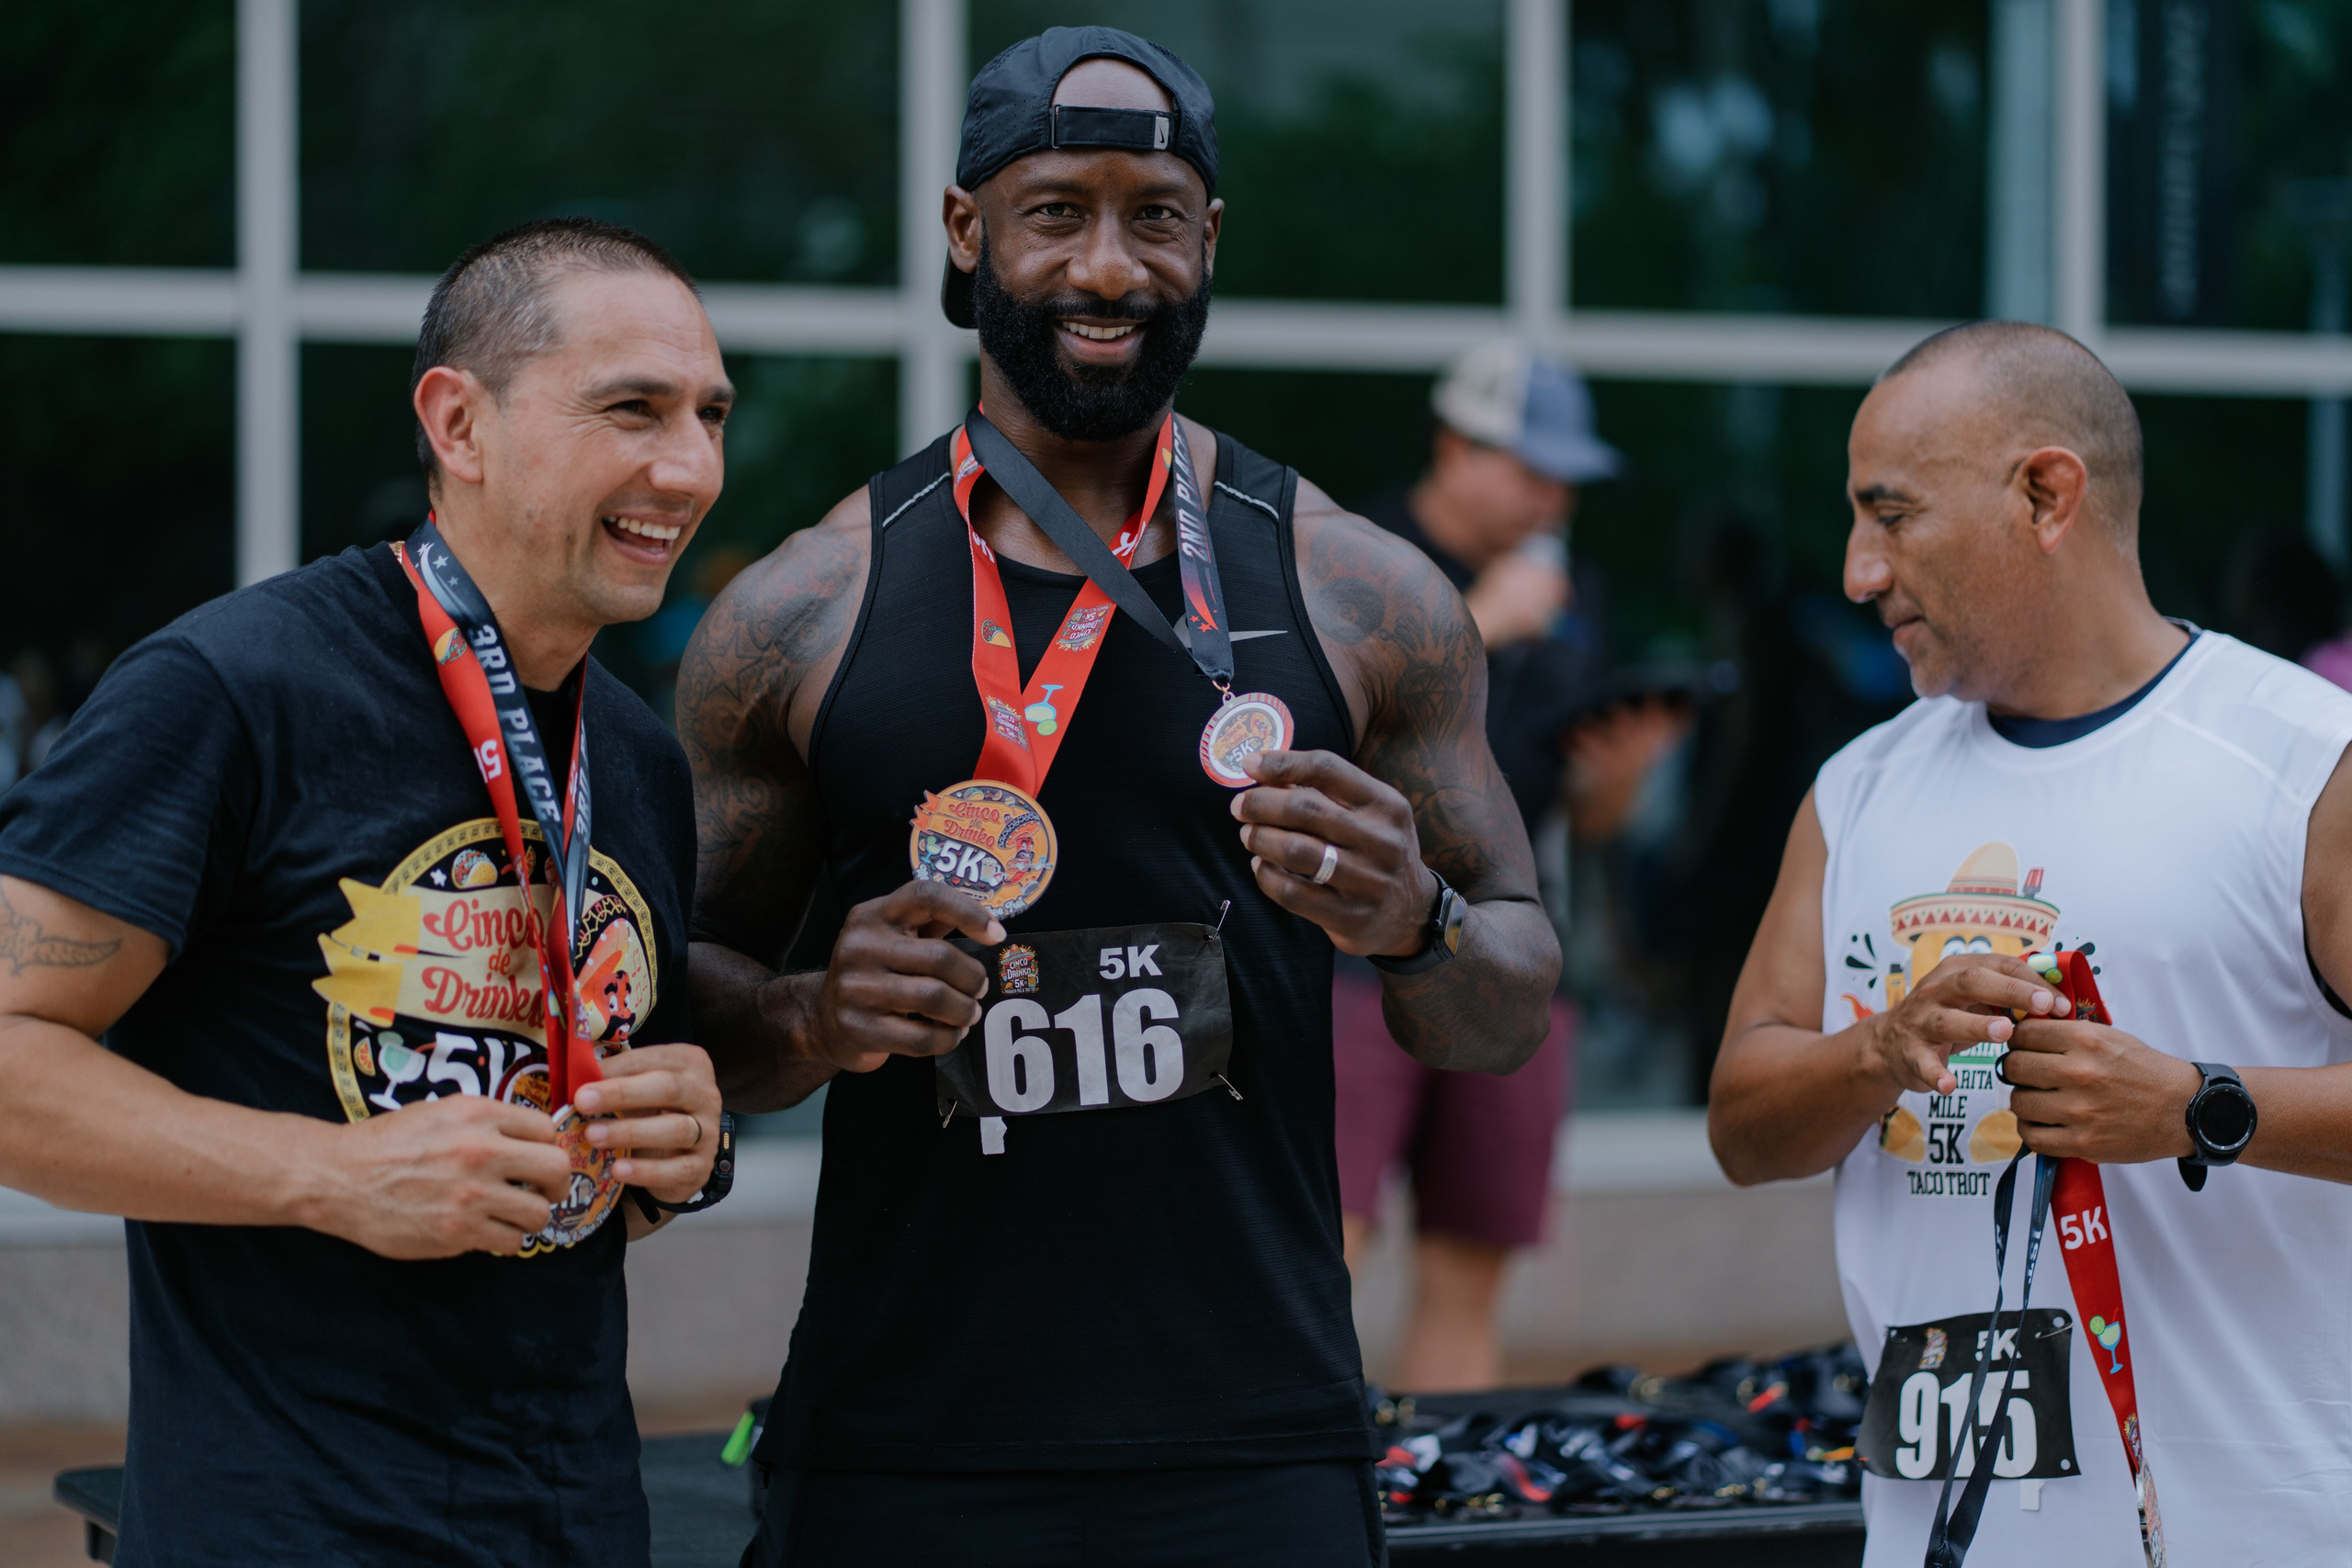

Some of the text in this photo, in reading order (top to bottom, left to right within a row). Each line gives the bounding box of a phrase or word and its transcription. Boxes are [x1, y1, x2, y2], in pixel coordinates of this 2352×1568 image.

[1179, 508, 1211, 564] 2ND
[469, 625, 561, 823] 3RD PLACE
[1232, 739, 1255, 762] 5K
[948, 802, 1001, 825] Cinco
[970, 818, 982, 828] de
[944, 818, 995, 851] Drinko
[935, 840, 987, 883] 5K
[423, 898, 548, 952] Cinco
[488, 947, 511, 976] de
[1007, 967, 1032, 980] DRINKO
[1009, 957, 1028, 970] CINCO
[1099, 943, 1163, 980] 5K
[422, 966, 545, 1029] Drinko
[1014, 978, 1025, 988] 5K
[983, 987, 1184, 1113] 616
[1954, 1069, 1994, 1090] ARITA
[1928, 1095, 1968, 1119] MILE
[1928, 1123, 1965, 1165] 5K
[1906, 1171, 1991, 1196] TACO TROT
[2060, 1205, 2108, 1250] 5K
[1974, 1327, 2022, 1362] 5K
[1895, 1370, 2038, 1480] 915
